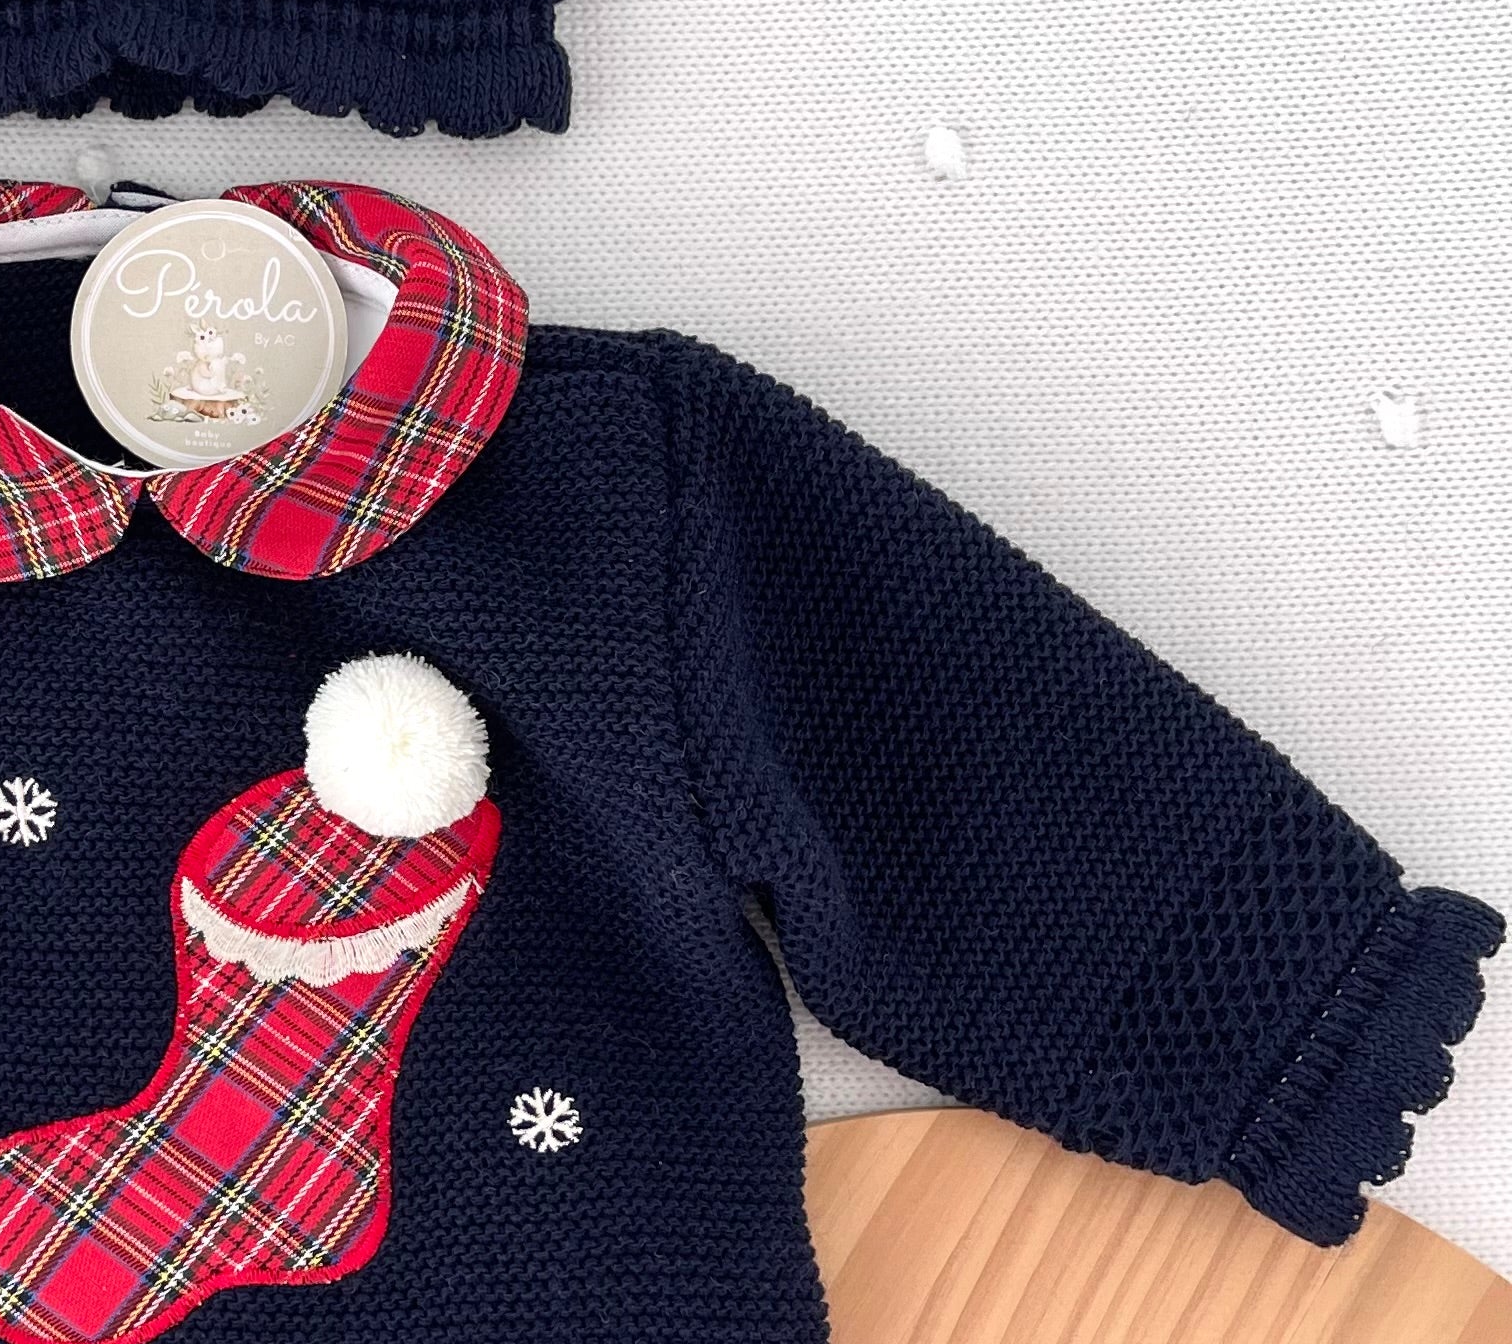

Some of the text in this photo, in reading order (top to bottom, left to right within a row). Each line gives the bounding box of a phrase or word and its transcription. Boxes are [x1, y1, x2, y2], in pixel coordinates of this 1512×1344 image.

[115, 249, 318, 323] Pérola
[254, 332, 295, 349] By AC
